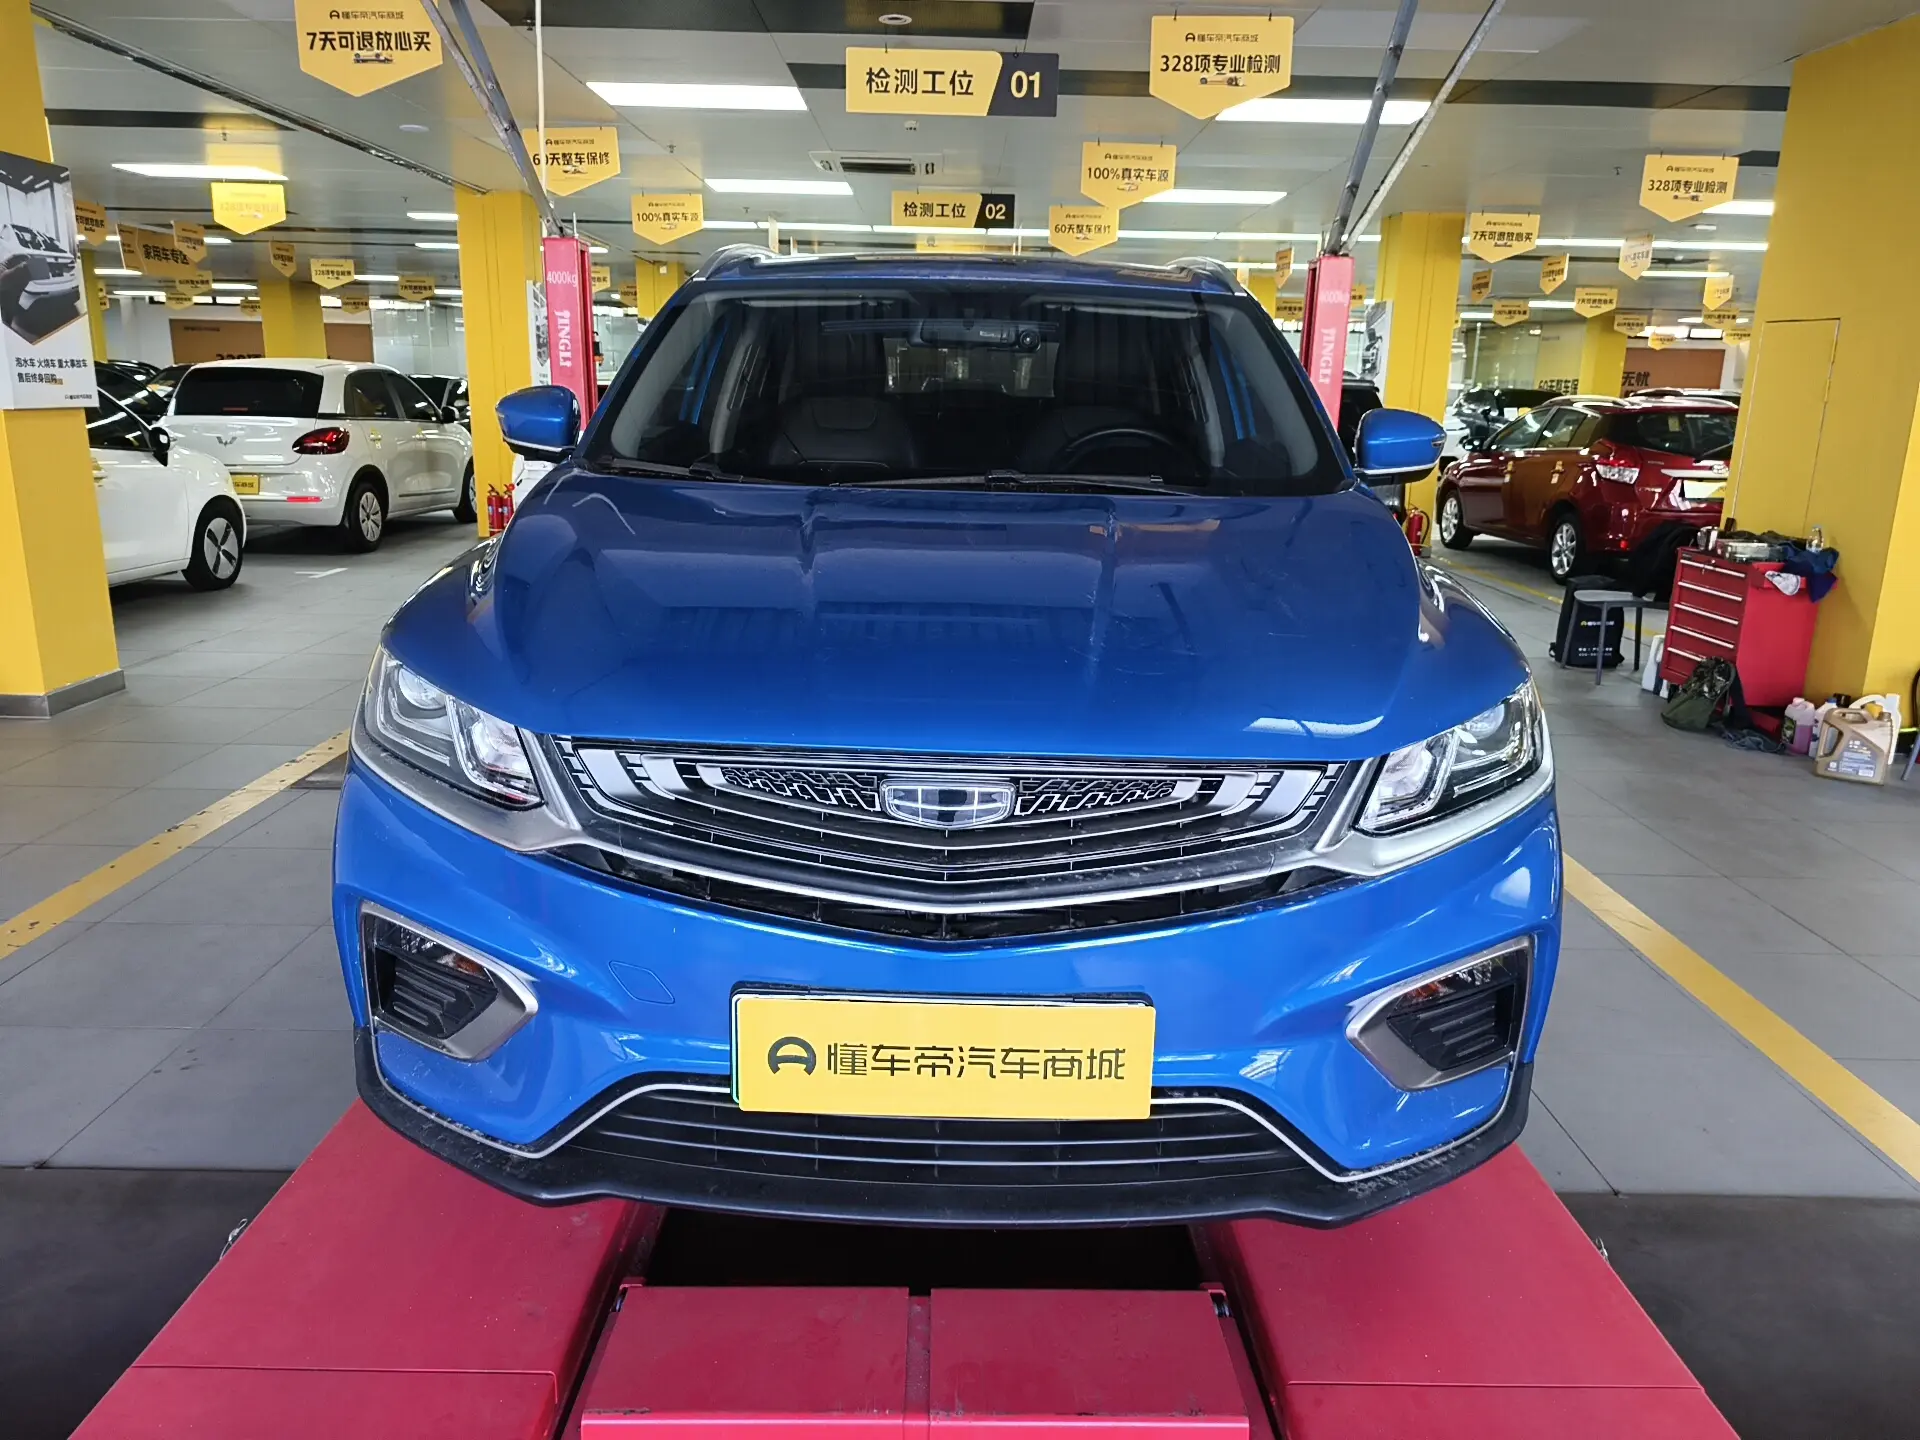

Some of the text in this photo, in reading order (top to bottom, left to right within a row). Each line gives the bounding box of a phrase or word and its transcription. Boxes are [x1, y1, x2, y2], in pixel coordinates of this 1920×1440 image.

[306, 31, 431, 51] 7天可退放心买
[1160, 54, 1281, 74] 328项专业检测
[866, 67, 1040, 98] 检测工位 01
[1087, 167, 1170, 182] 100%真实车源
[1647, 179, 1728, 194] 328项专业检测
[636, 212, 699, 222] 100%真实车源
[903, 201, 1006, 220] 检测工位 02
[546, 270, 578, 288] 4000kg
[554, 309, 573, 368] JINGLI
[827, 1043, 1126, 1080] 懂车帝汽车商城
